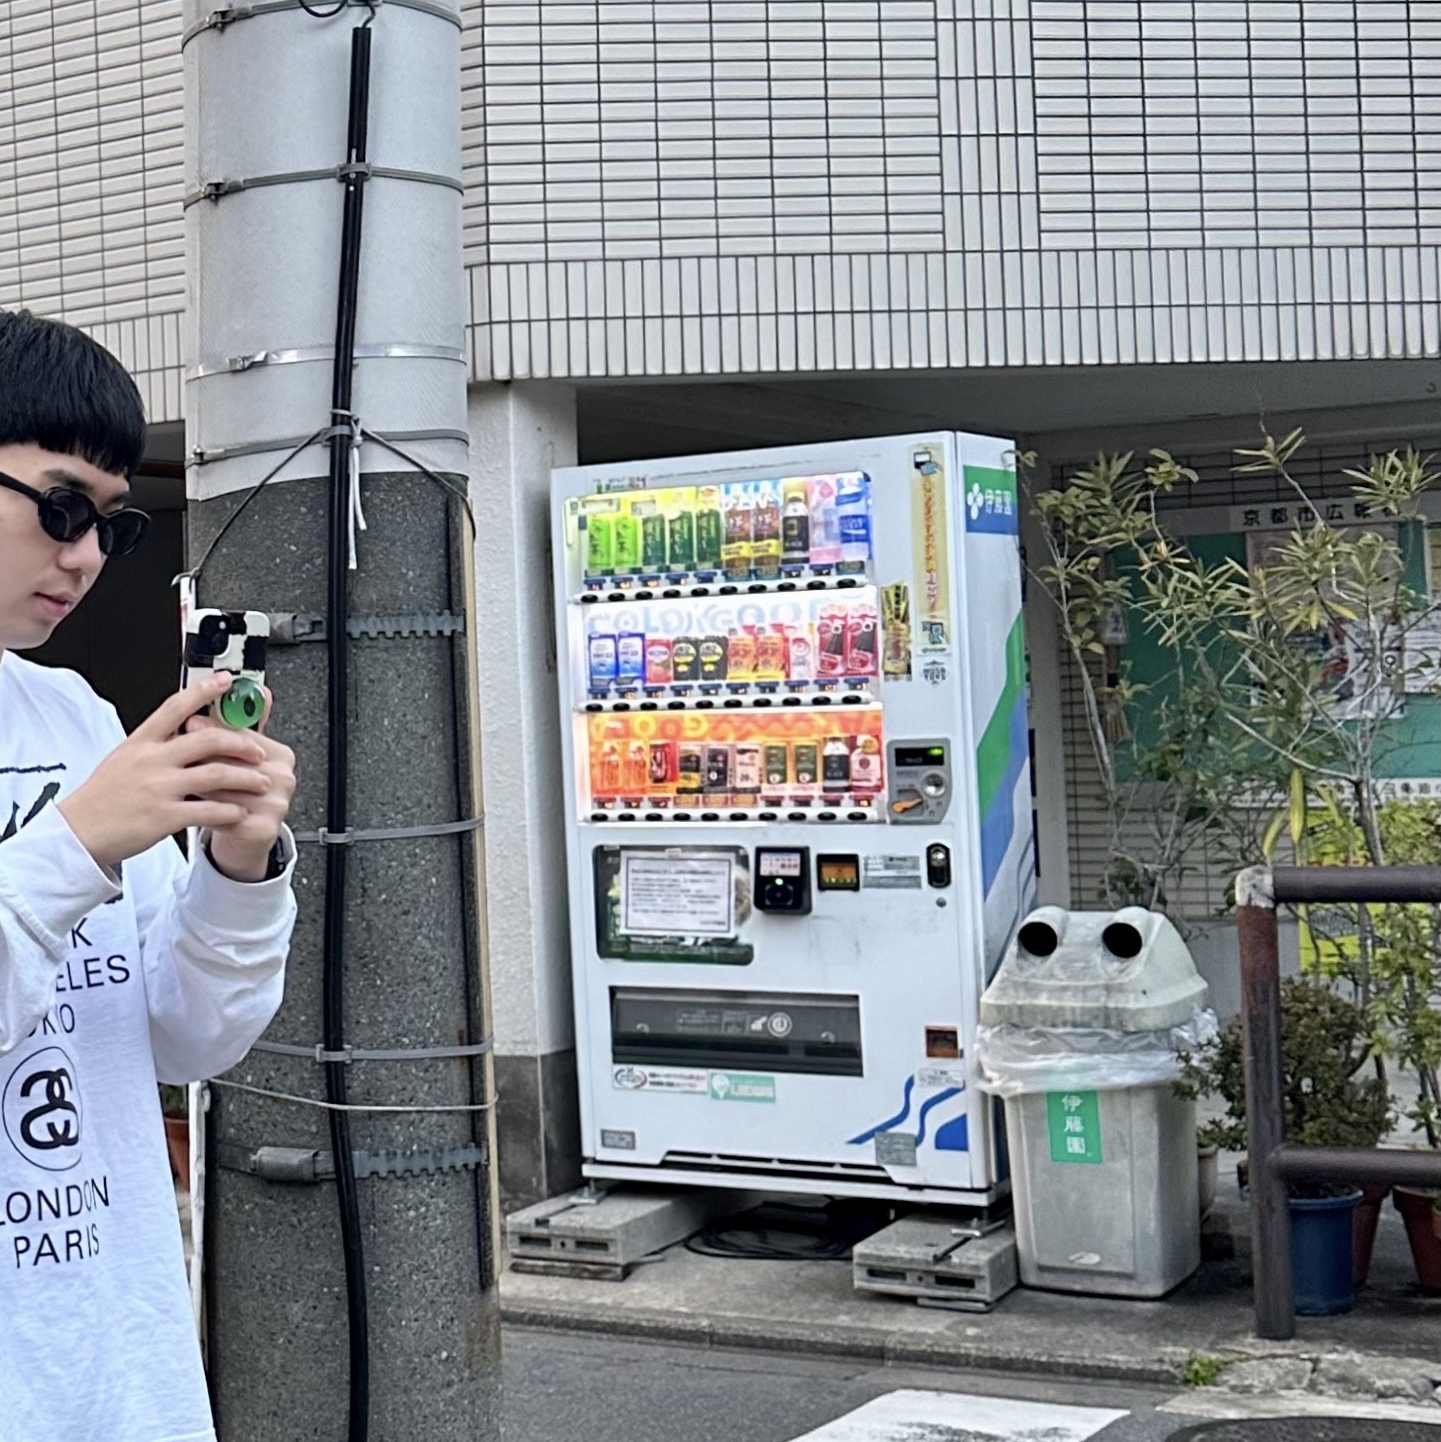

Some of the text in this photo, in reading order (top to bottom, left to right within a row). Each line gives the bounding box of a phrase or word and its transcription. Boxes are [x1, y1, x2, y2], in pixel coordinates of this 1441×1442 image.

[1061, 1094, 1087, 1154] 伊藤園
[13, 1223, 101, 1269] PARIS
